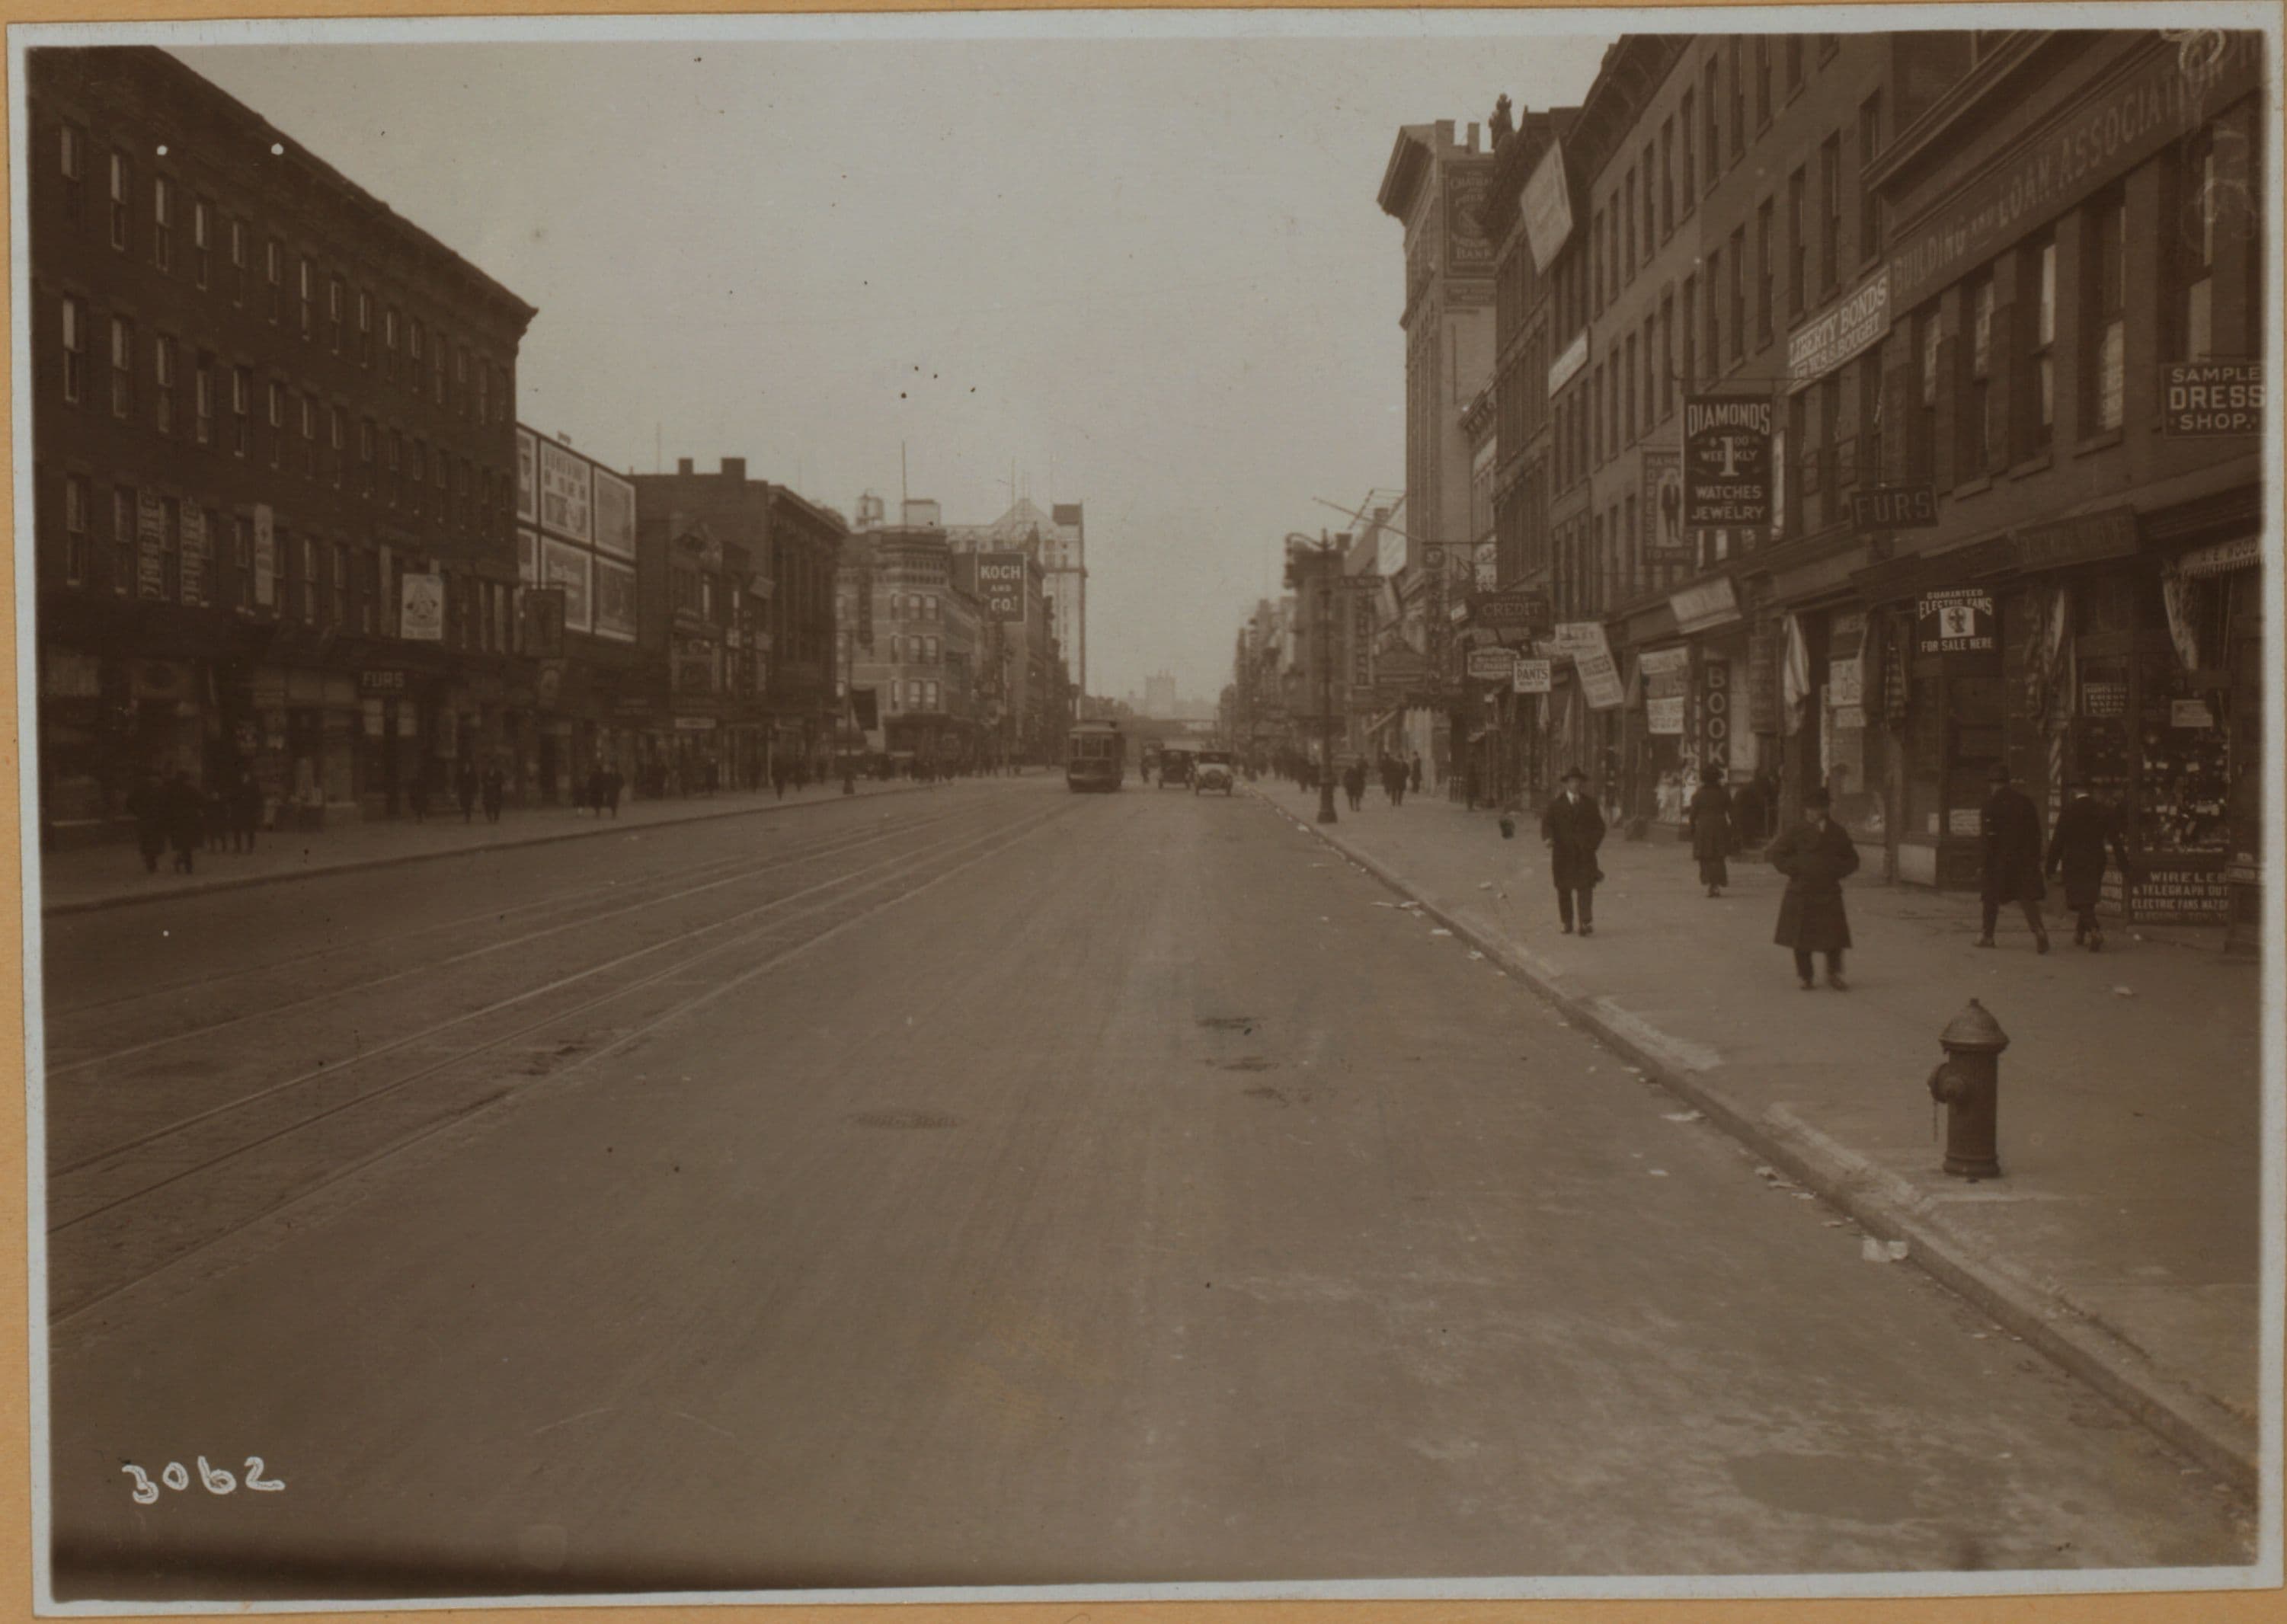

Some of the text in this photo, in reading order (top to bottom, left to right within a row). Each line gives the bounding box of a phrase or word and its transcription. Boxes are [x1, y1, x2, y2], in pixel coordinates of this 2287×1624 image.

[1894, 215, 1966, 298] BUILDING
[1998, 155, 2051, 228] LOAN
[1789, 276, 1888, 368] LIBERTY BONDS
[1837, 312, 1880, 358] BOUGHT
[2171, 367, 2262, 383] SAMPLE
[2169, 385, 2265, 410] DRESS
[1688, 404, 1770, 438] DIAMONDS
[2180, 413, 2252, 430] SHOP.
[1695, 485, 1761, 500] WATCHES
[1691, 506, 1765, 520] JEWELRY
[1855, 491, 1931, 526] FURS
[980, 565, 1021, 580] KOCH
[990, 584, 1012, 593] AND
[1927, 589, 1984, 599] GUARANTEED
[1482, 602, 1540, 617] CREDIT
[1919, 597, 1992, 620] ELECTRIC FANS
[1921, 638, 1992, 652] FOR SALE HERE
[363, 671, 405, 688] FURS
[1517, 668, 1548, 680] PANTS
[2142, 884, 2204, 897] TELEGRAPH
[2132, 898, 2176, 910] ELECTRIC
[2178, 898, 2199, 910] FANS
